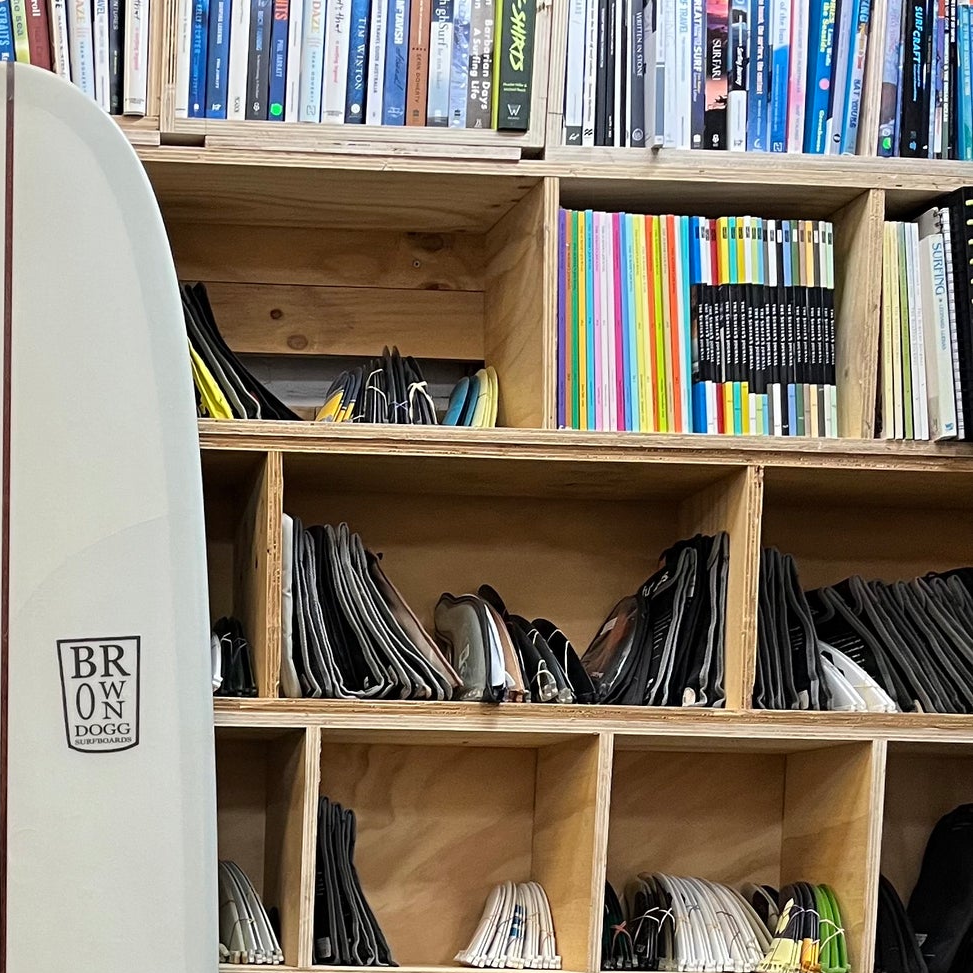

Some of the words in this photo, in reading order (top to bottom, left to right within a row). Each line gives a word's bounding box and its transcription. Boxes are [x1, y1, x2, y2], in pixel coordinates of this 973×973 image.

[15, 16, 23, 36] sea
[312, 1, 321, 33] DAZE
[358, 17, 366, 38] TIM
[915, 6, 923, 31] SURF
[473, 28, 481, 36] A
[470, 39, 481, 77] Surfing
[482, 19, 493, 77] Barbarian
[735, 47, 743, 65] Surfing
[913, 30, 921, 63] CRAFT
[354, 44, 365, 90] WINTON
[693, 47, 702, 72] SURF
[712, 39, 721, 80] SURFARI
[735, 65, 743, 86] Journey
[470, 81, 479, 99] Life
[479, 81, 490, 110] Days
[931, 242, 945, 296] SURFING
[74, 723, 132, 737] DOGG
[75, 737, 132, 746] SURFBOARDS
